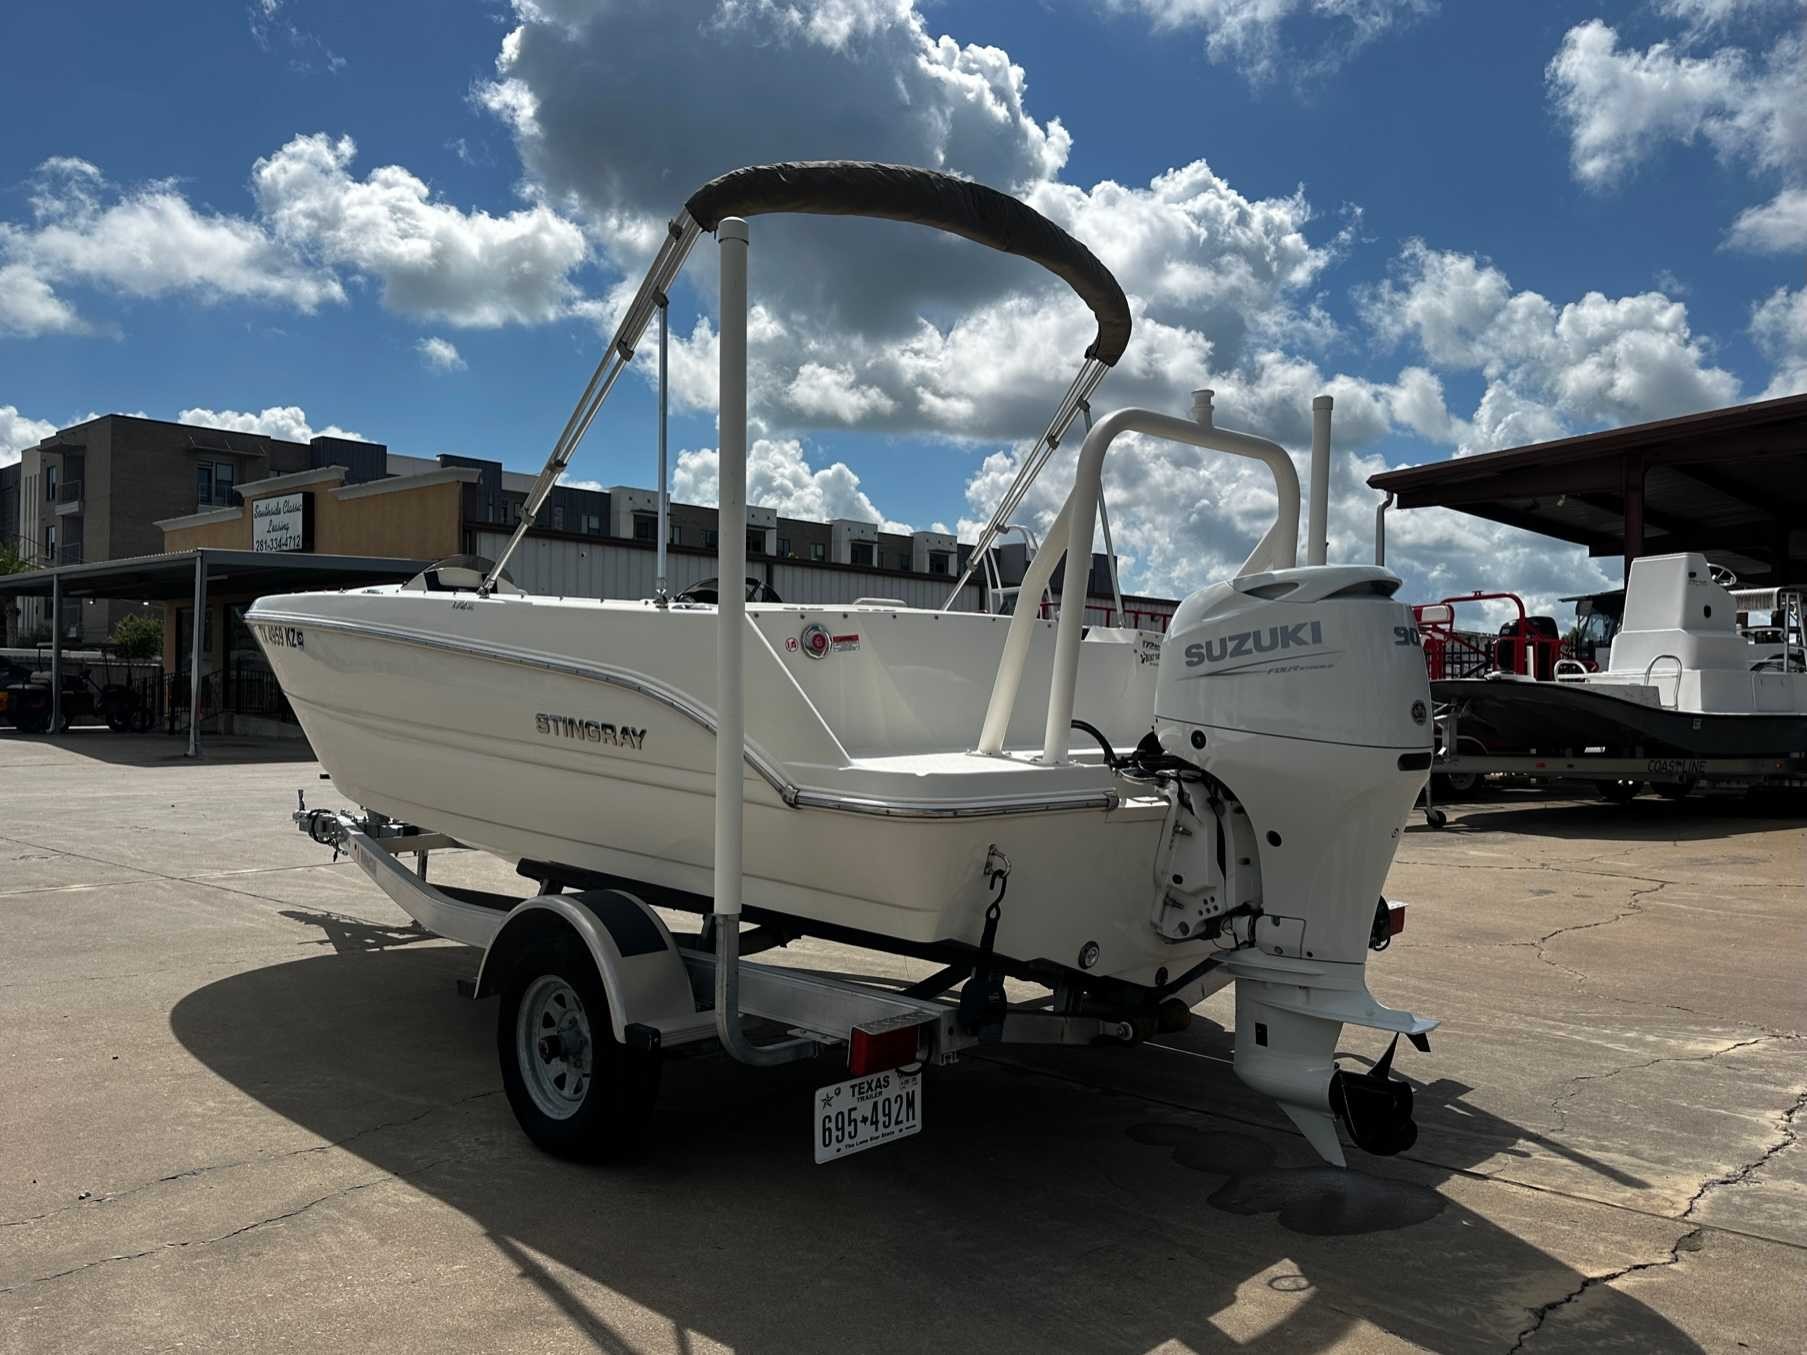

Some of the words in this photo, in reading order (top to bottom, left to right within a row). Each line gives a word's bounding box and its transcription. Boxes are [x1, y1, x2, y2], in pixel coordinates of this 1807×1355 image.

[256, 535, 300, 551] 281-334-4712
[285, 627, 297, 648] KZ
[1185, 621, 1322, 667] SUZUKI
[1393, 626, 1421, 647] 90
[536, 713, 647, 750] STINGRAY
[849, 1075, 890, 1098] TEXAS
[857, 1090, 883, 1103] TRAILER
[856, 1138, 869, 1147] Lone
[881, 1130, 895, 1138] State
